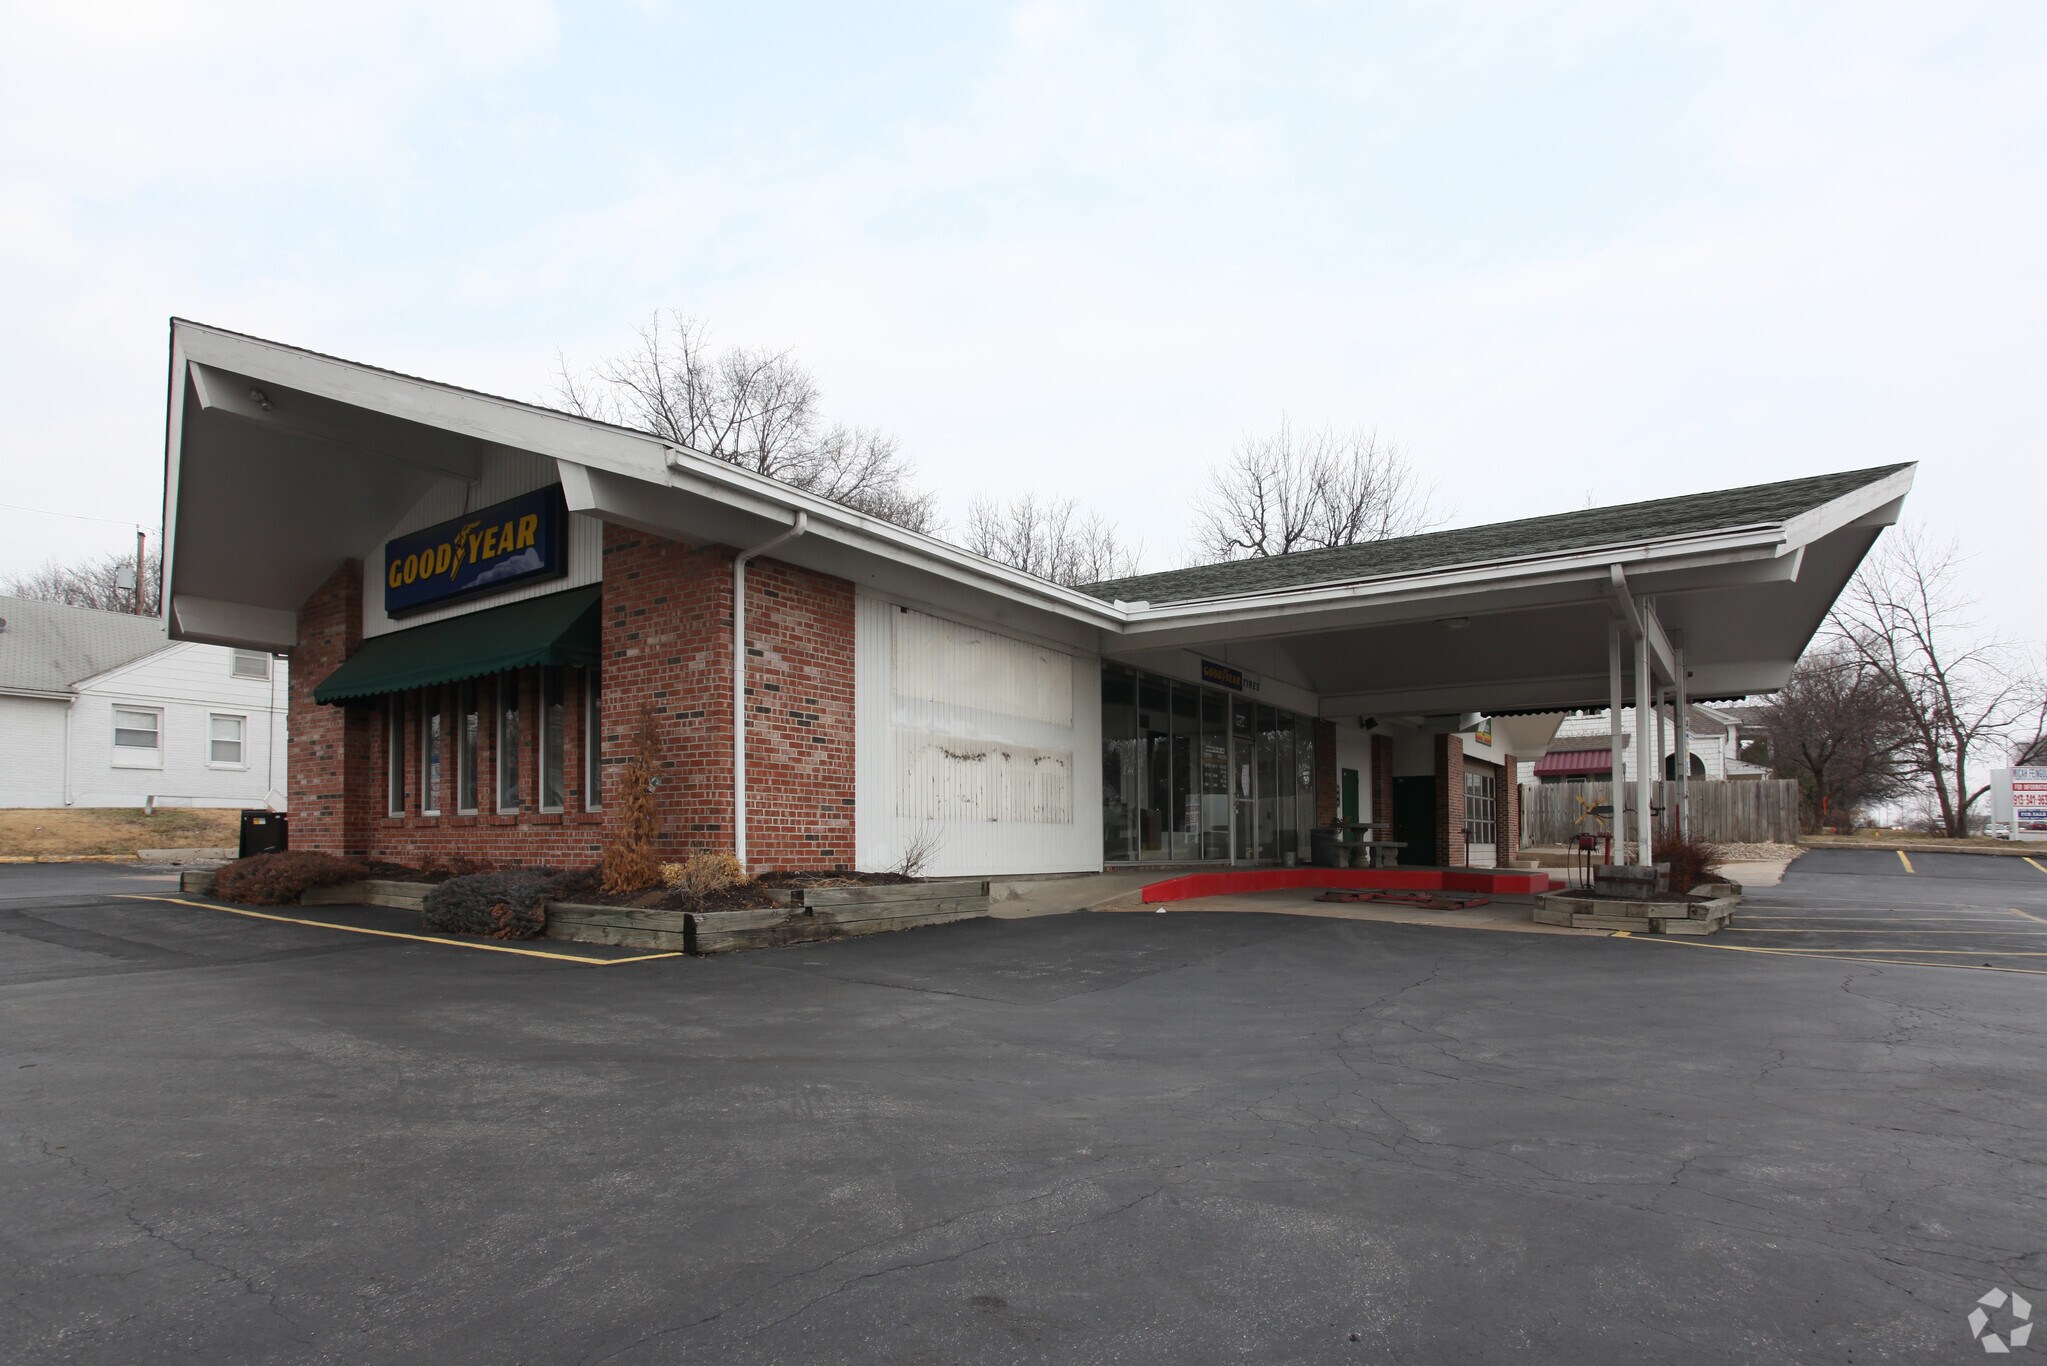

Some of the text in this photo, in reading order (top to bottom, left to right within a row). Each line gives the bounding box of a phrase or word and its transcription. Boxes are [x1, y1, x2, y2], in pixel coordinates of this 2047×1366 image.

[389, 514, 538, 589] GOODYEAR
[1204, 666, 1260, 691] GOODYEAR TIRES
